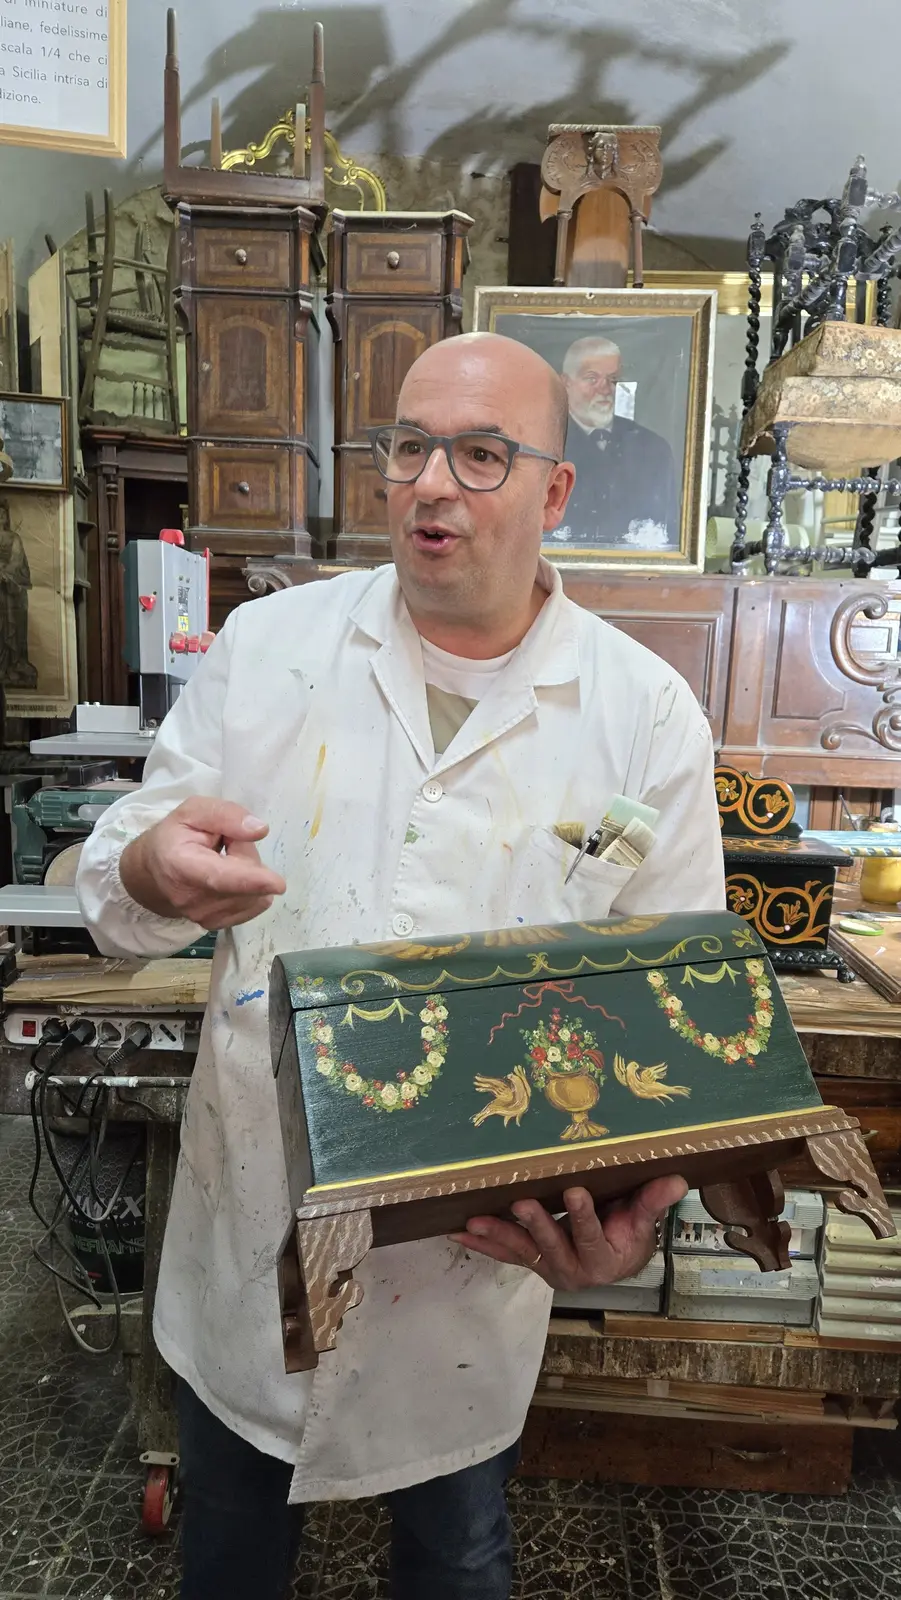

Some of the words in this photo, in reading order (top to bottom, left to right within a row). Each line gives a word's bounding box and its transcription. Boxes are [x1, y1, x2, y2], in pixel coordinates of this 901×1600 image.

[96, 6, 108, 18] di
[40, 21, 108, 41] fedelissime
[1, 42, 33, 55] scala
[41, 46, 61, 59] 1/4
[68, 50, 91, 63] che
[98, 55, 108, 65] ci
[13, 66, 47, 81] Sicilia
[54, 72, 90, 87] intrisa
[97, 77, 108, 89] di
[0, 88, 41, 104] izione.
